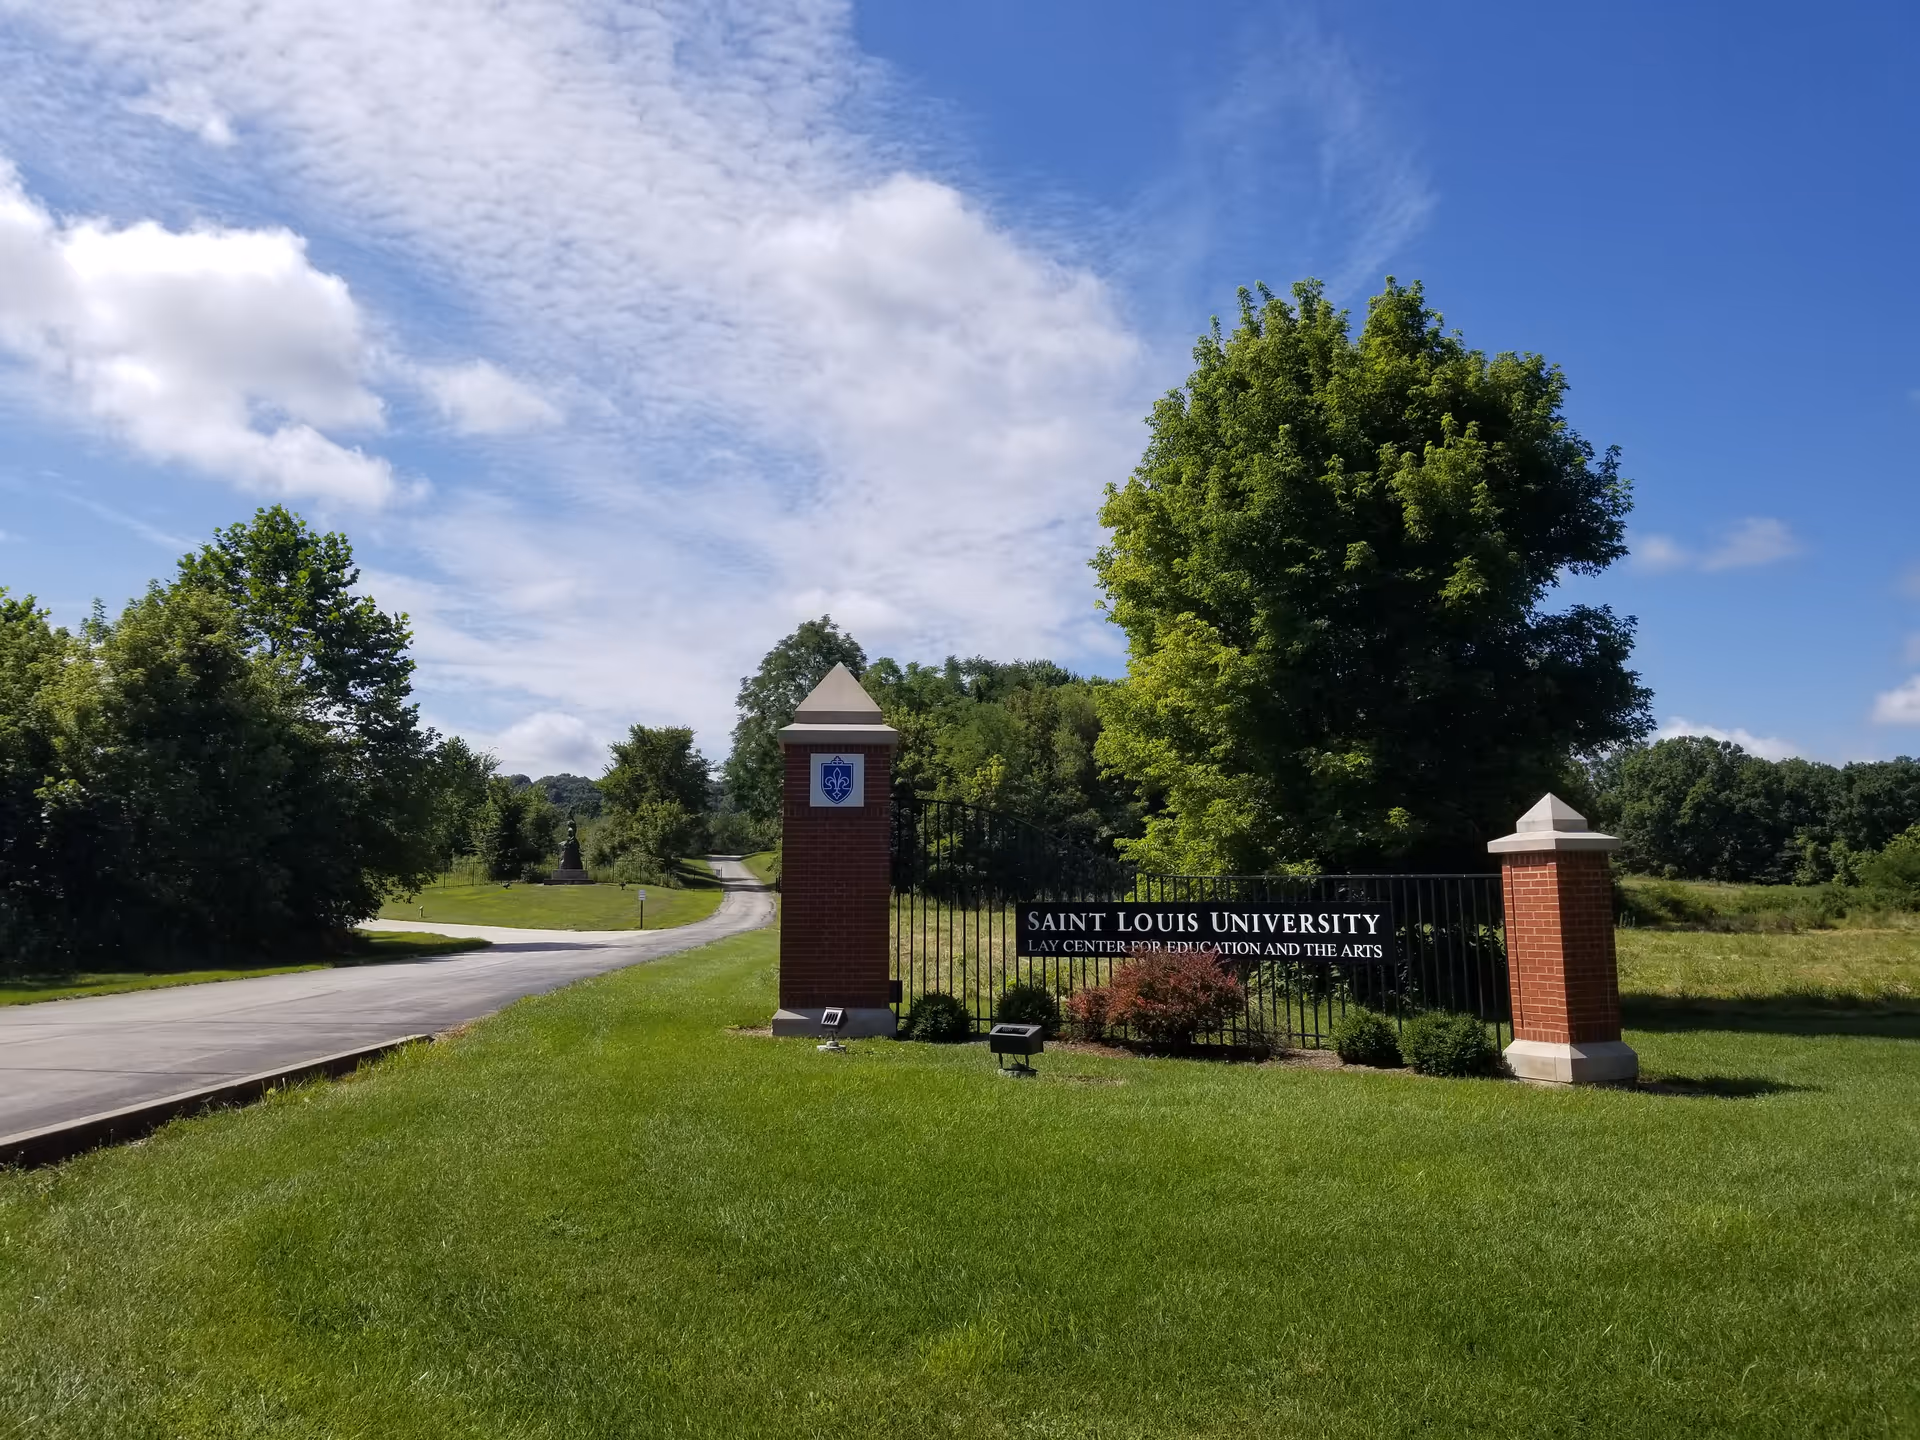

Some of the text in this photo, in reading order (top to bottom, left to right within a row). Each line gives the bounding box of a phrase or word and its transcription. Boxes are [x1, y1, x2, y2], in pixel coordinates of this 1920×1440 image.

[1027, 910, 1381, 935] SAINT LOUIS UNIVERSITY
[1027, 939, 1383, 959] LAY CENTER FOR EDUCATION AND THE ARTS
